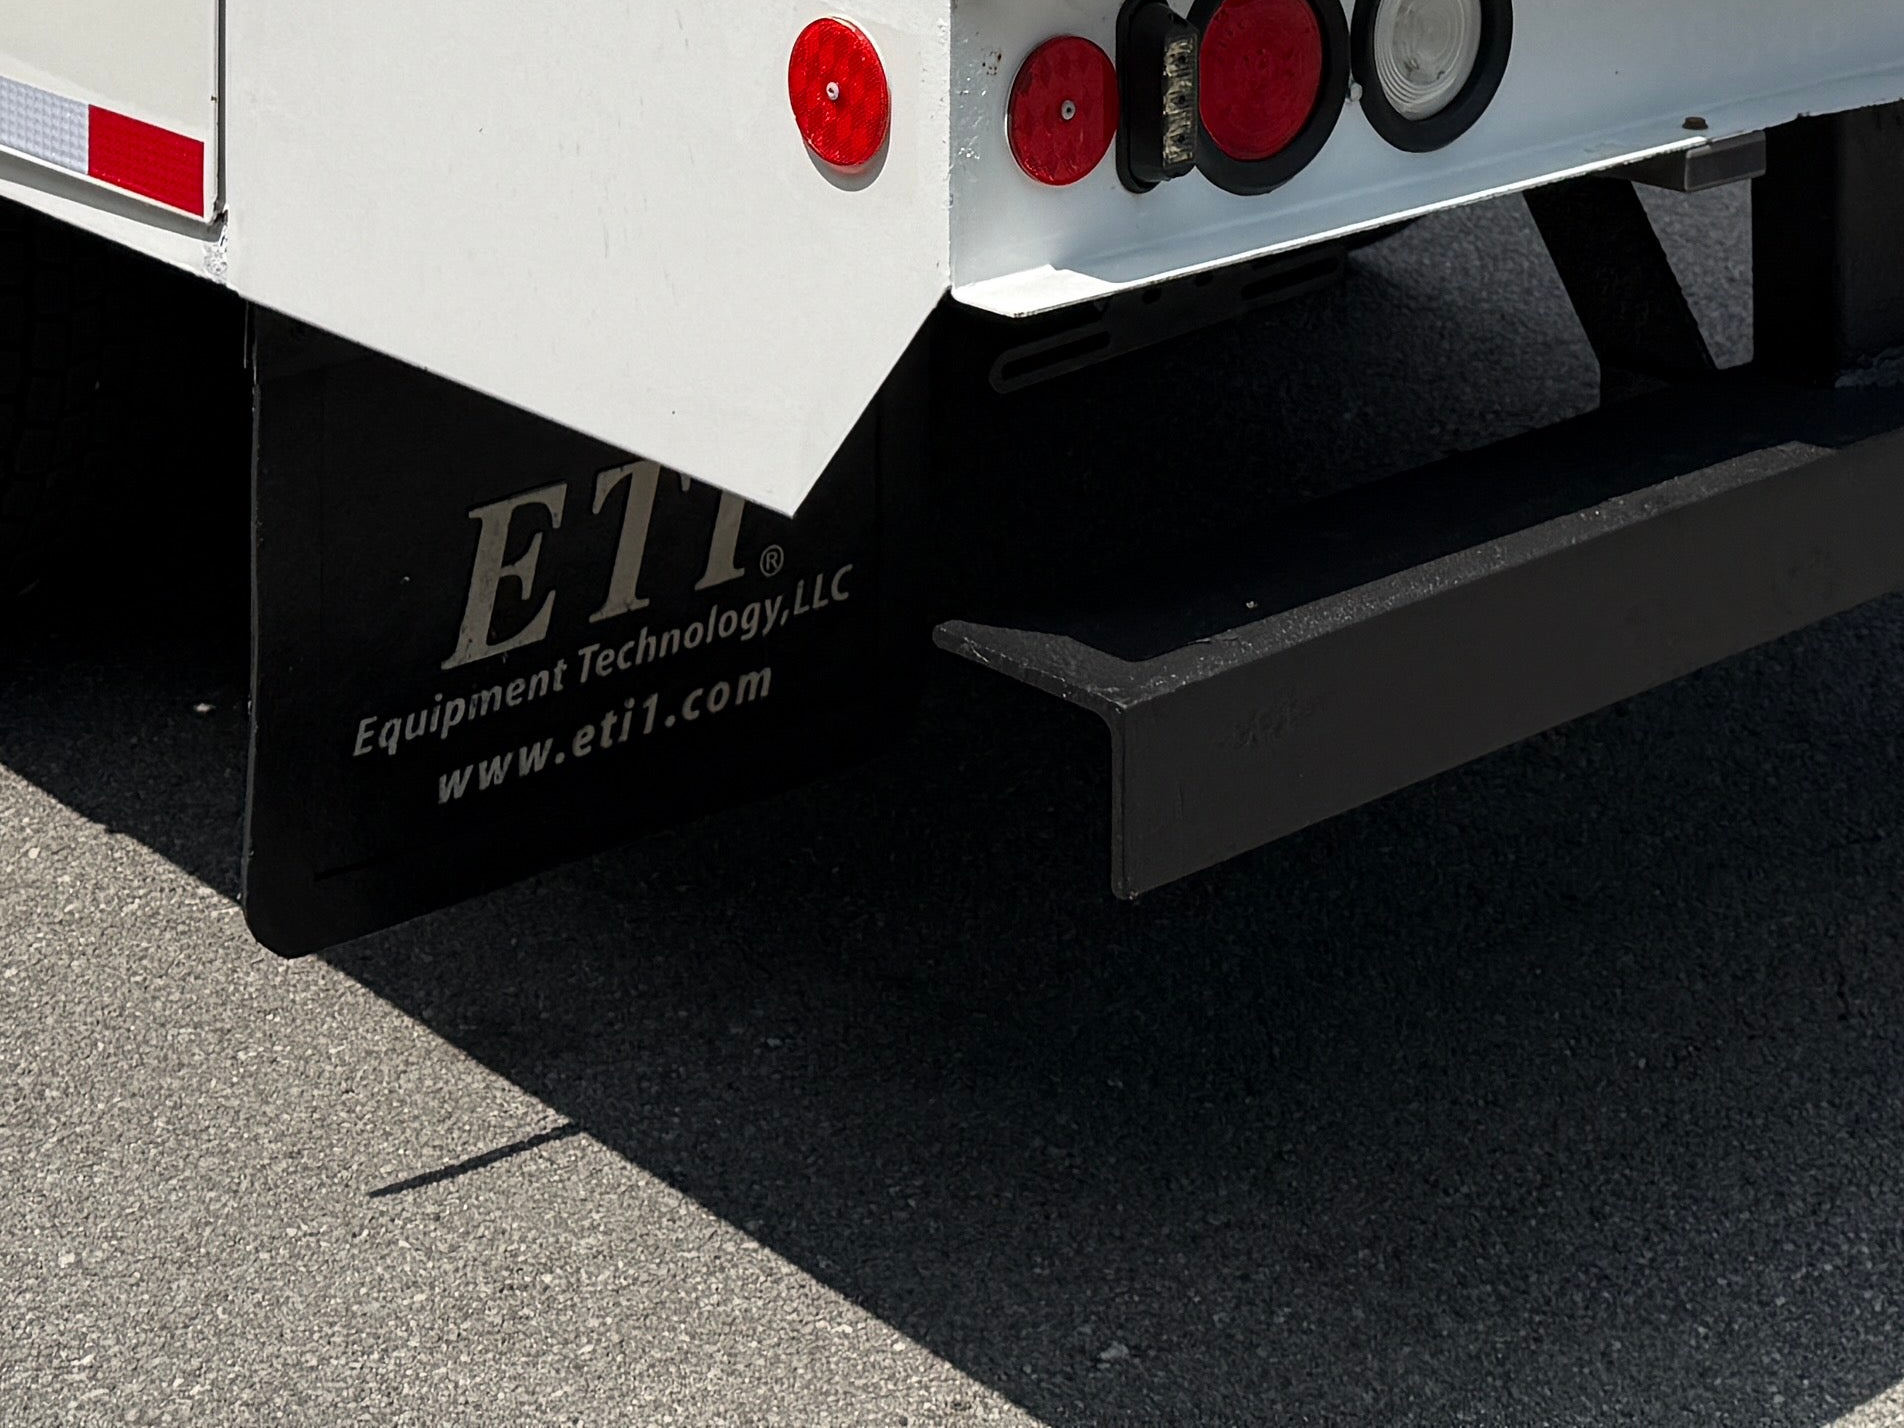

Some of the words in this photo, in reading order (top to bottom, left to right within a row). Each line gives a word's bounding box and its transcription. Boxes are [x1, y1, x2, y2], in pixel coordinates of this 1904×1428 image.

[352, 659, 568, 757] Equipment
[577, 564, 854, 684] Technology,LLC
[437, 666, 773, 805] www.eti1.com
